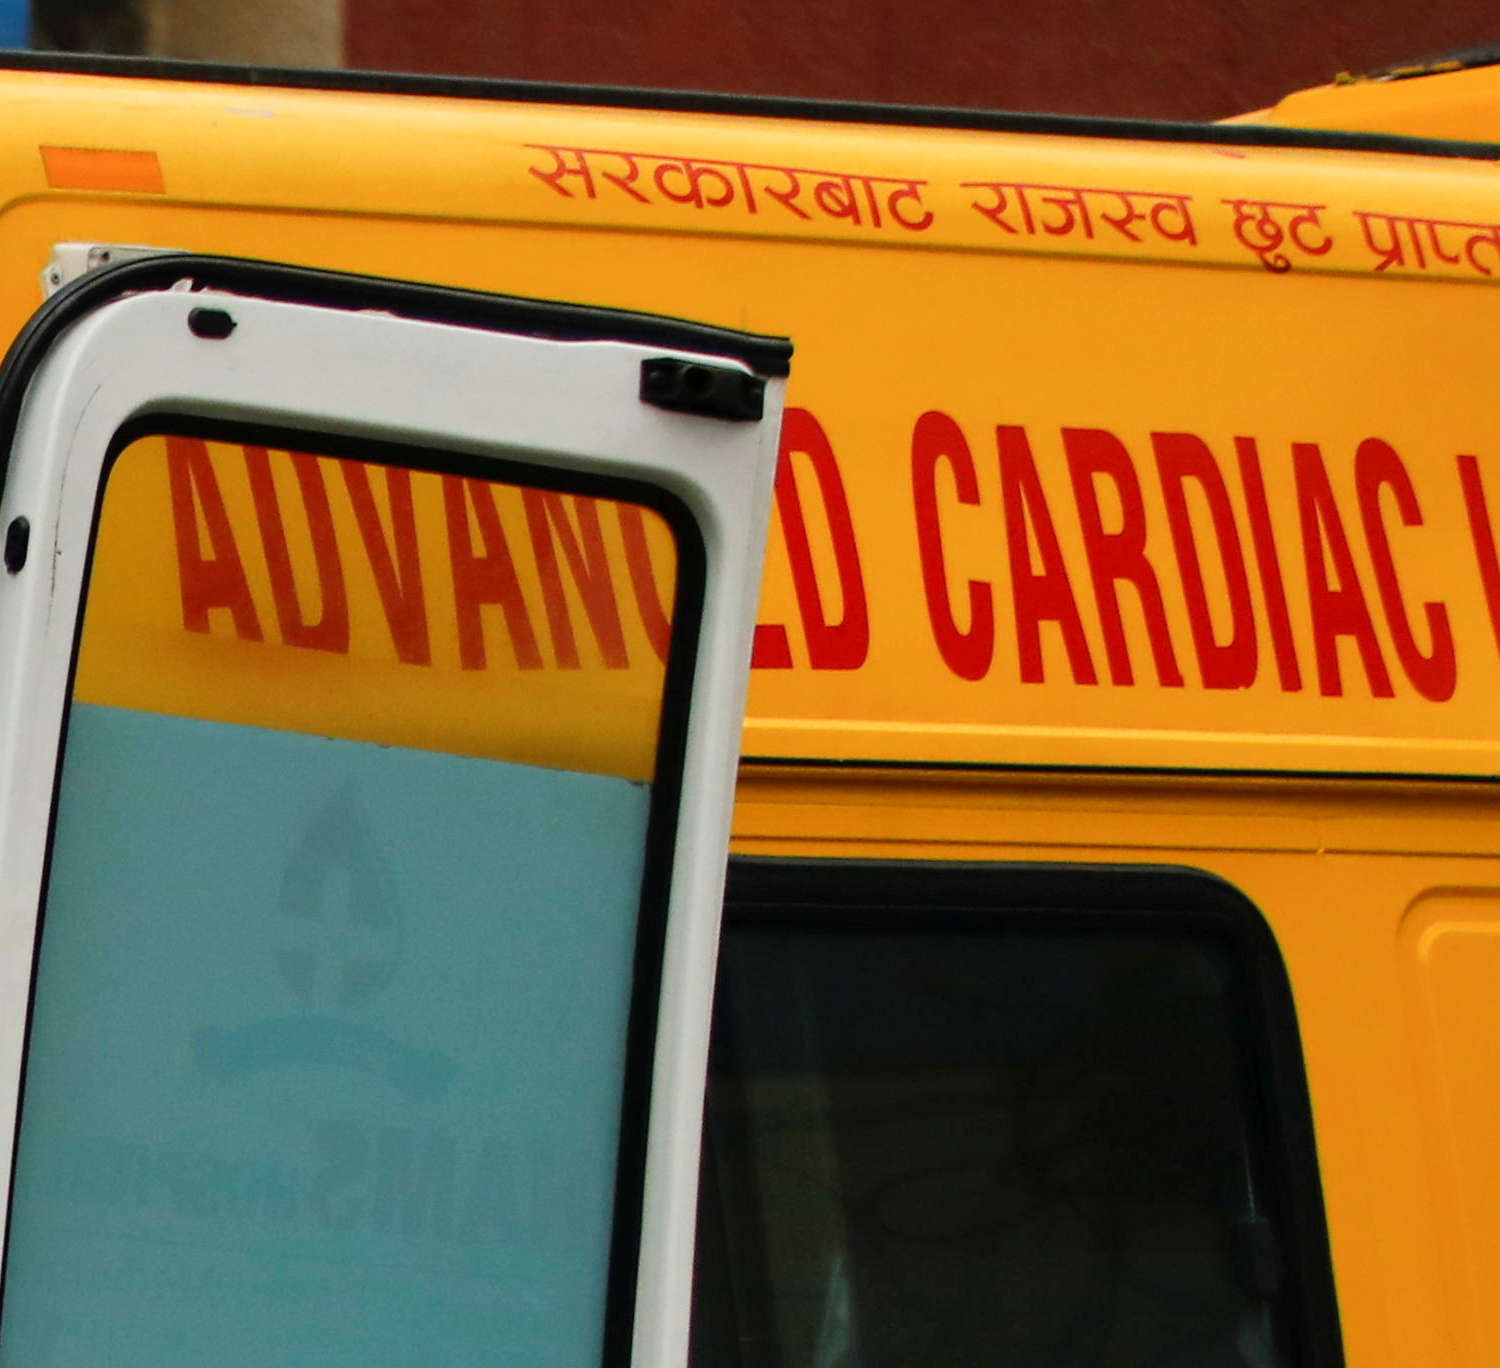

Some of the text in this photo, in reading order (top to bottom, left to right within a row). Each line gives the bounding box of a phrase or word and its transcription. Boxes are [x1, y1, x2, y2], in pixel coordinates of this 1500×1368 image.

[521, 144, 935, 231] सरकारबाट
[960, 181, 1197, 248] राजस्व
[910, 410, 1457, 704] CARDIAC
